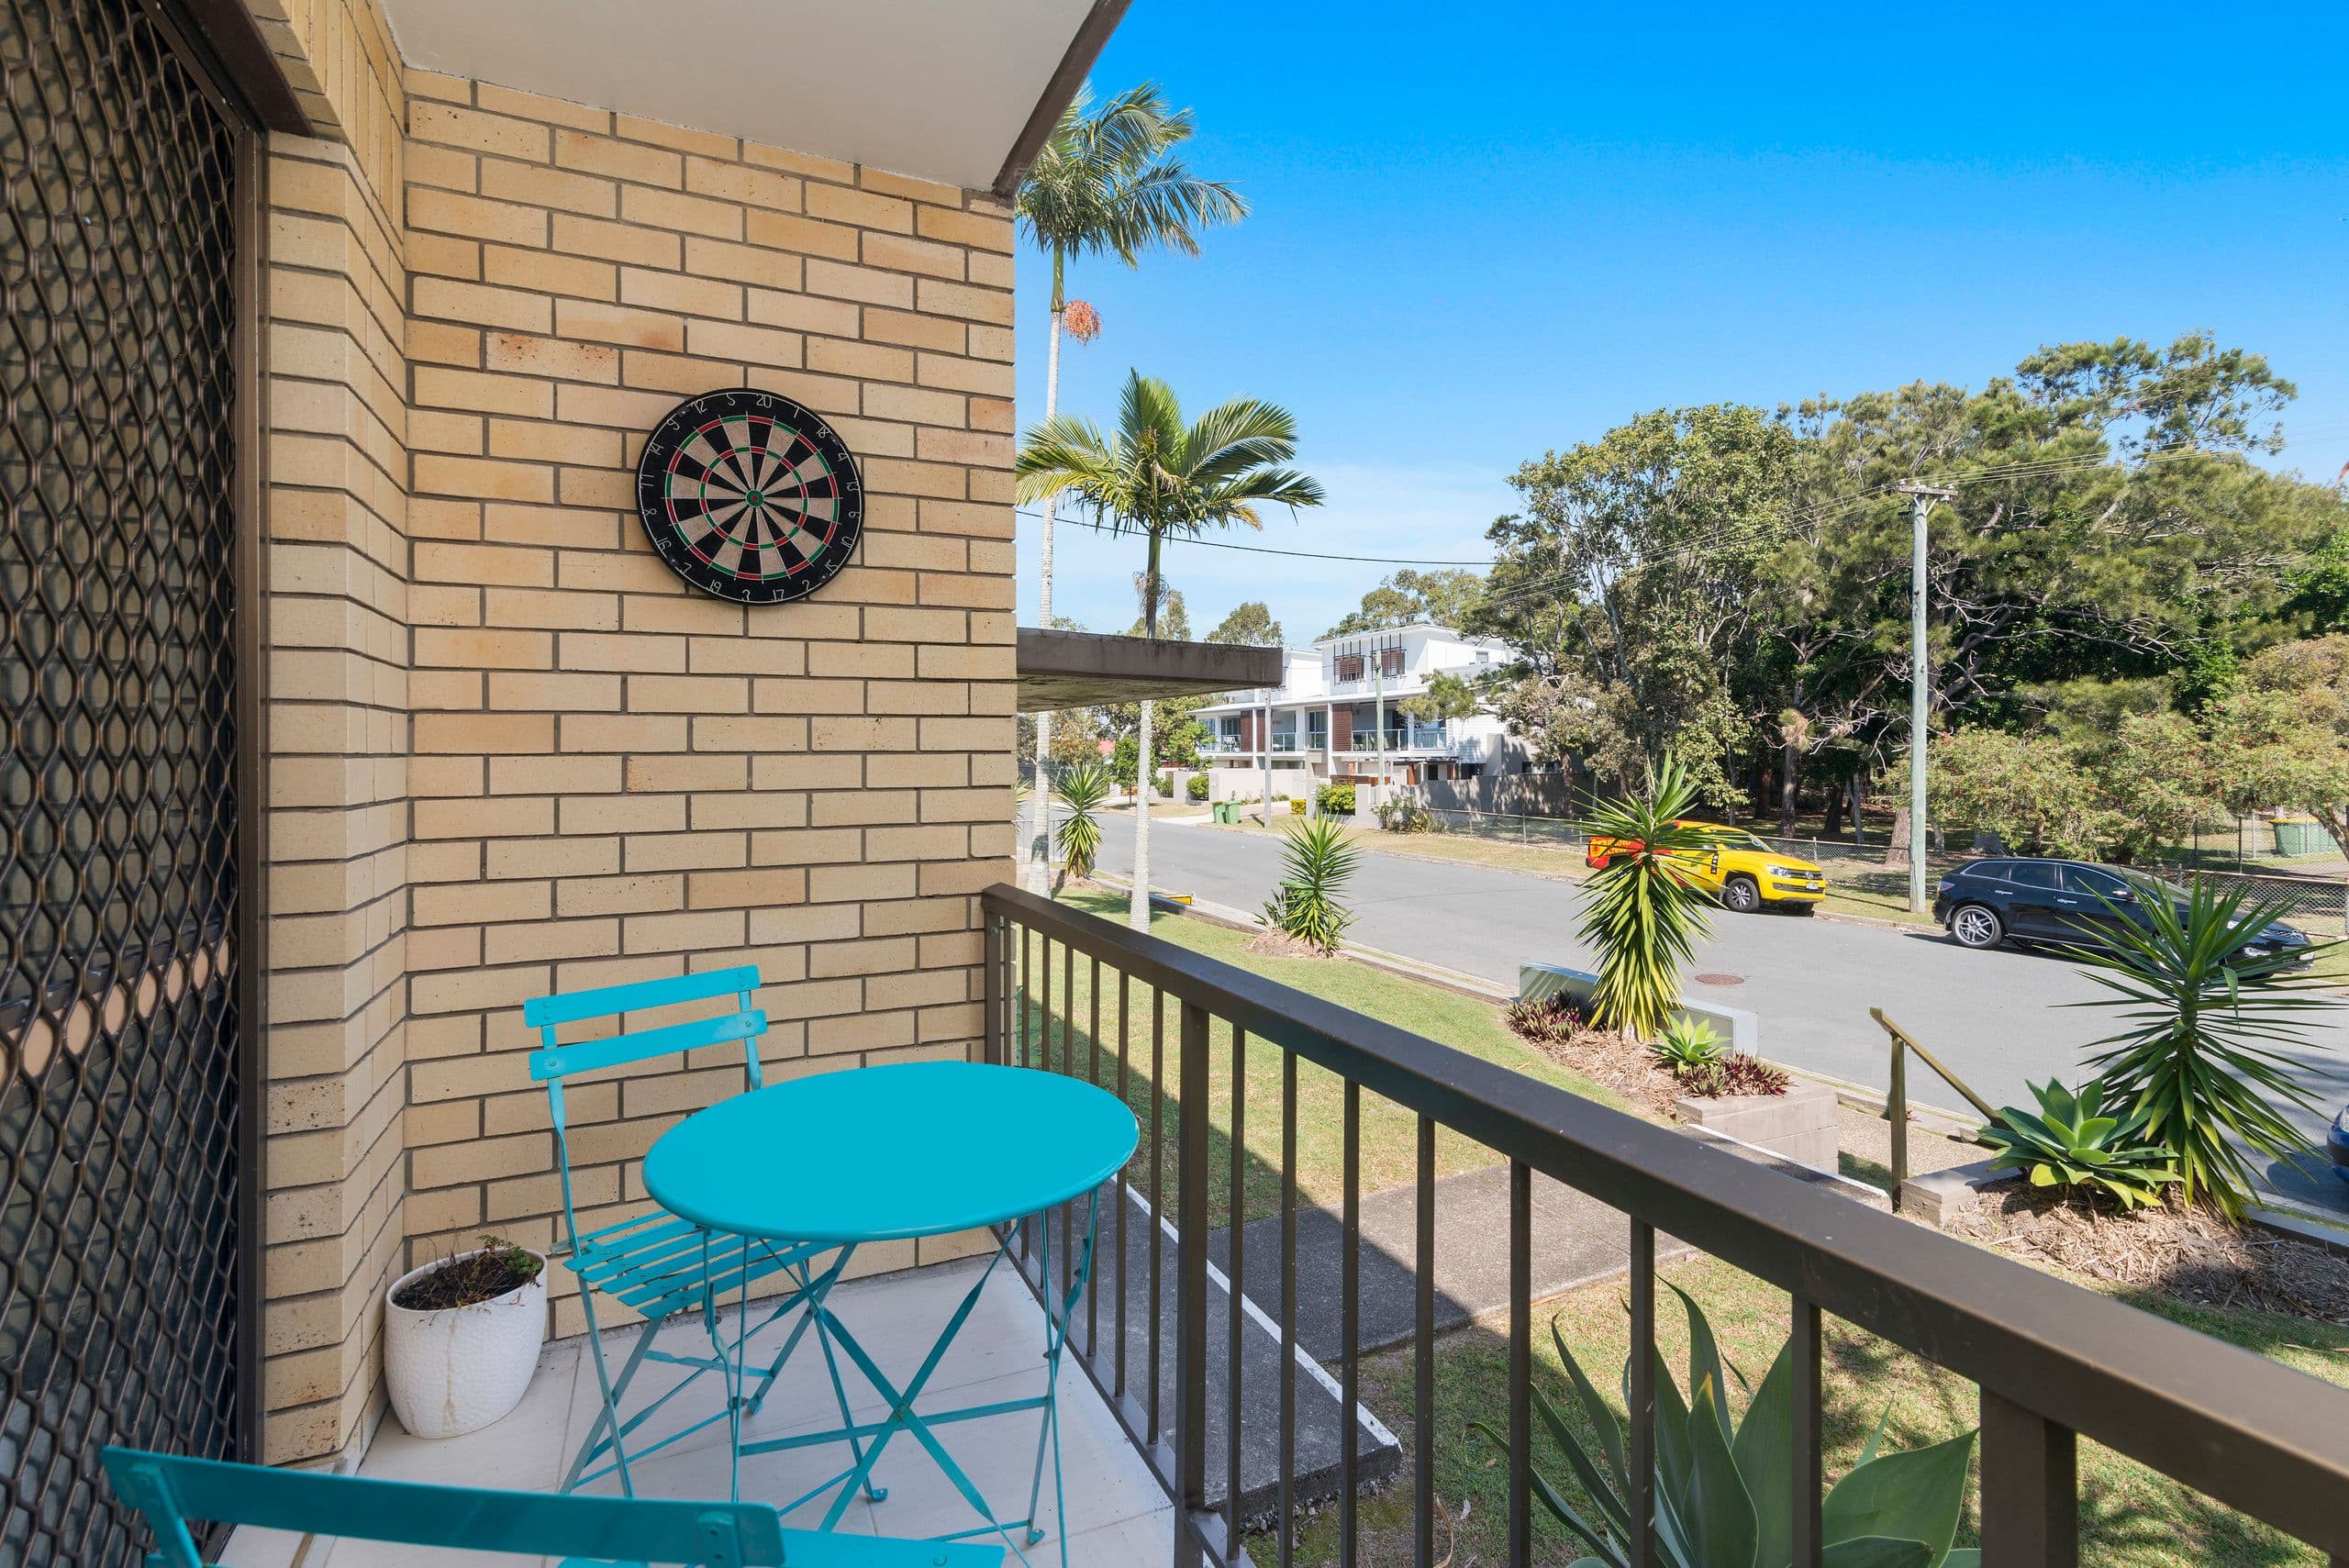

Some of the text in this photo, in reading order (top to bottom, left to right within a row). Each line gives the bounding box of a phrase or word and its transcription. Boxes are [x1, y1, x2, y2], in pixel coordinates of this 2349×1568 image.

[727, 394, 735, 406] 5
[756, 394, 773, 408] 20
[691, 399, 707, 414] 12
[793, 406, 800, 418] 1
[667, 418, 679, 430] 9
[817, 426, 830, 438] 18
[647, 442, 664, 455] 14
[838, 452, 849, 462] 4
[640, 473, 654, 489] 11
[846, 481, 860, 491] 13
[654, 538, 672, 550] 16
[841, 536, 853, 549] 10
[680, 562, 692, 574] 7
[825, 559, 839, 576] 15
[706, 579, 721, 594] 19
[802, 580, 809, 591] 2
[742, 589, 751, 602] 3
[771, 589, 785, 602] 17
